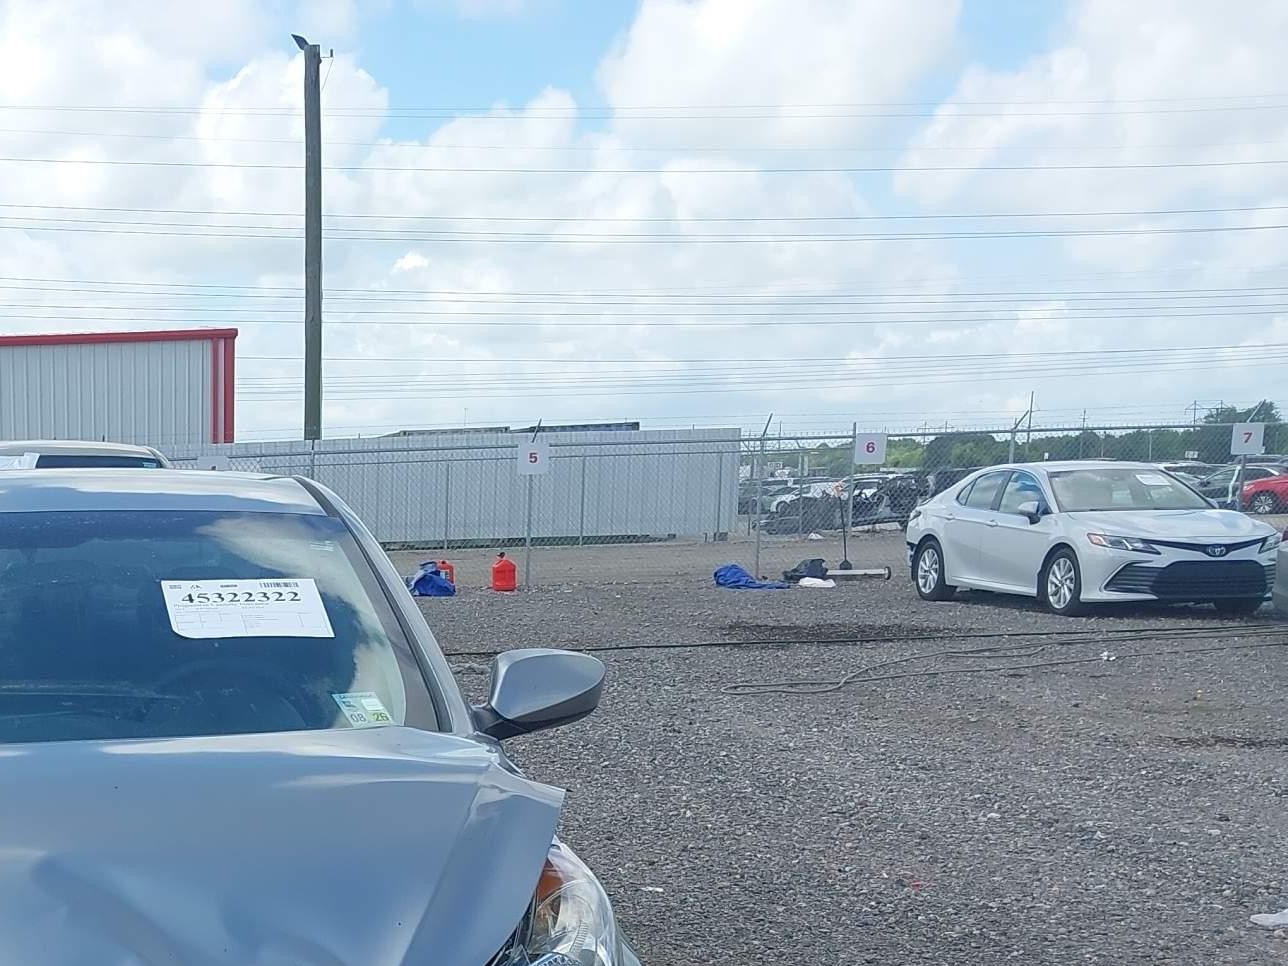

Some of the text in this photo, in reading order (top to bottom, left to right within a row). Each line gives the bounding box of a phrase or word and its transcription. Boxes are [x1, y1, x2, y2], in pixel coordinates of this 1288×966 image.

[1243, 432, 1253, 443] 7
[866, 441, 875, 453] 6
[528, 452, 538, 464] 5
[181, 591, 301, 604] 45322322
[351, 712, 389, 722] 08 26
